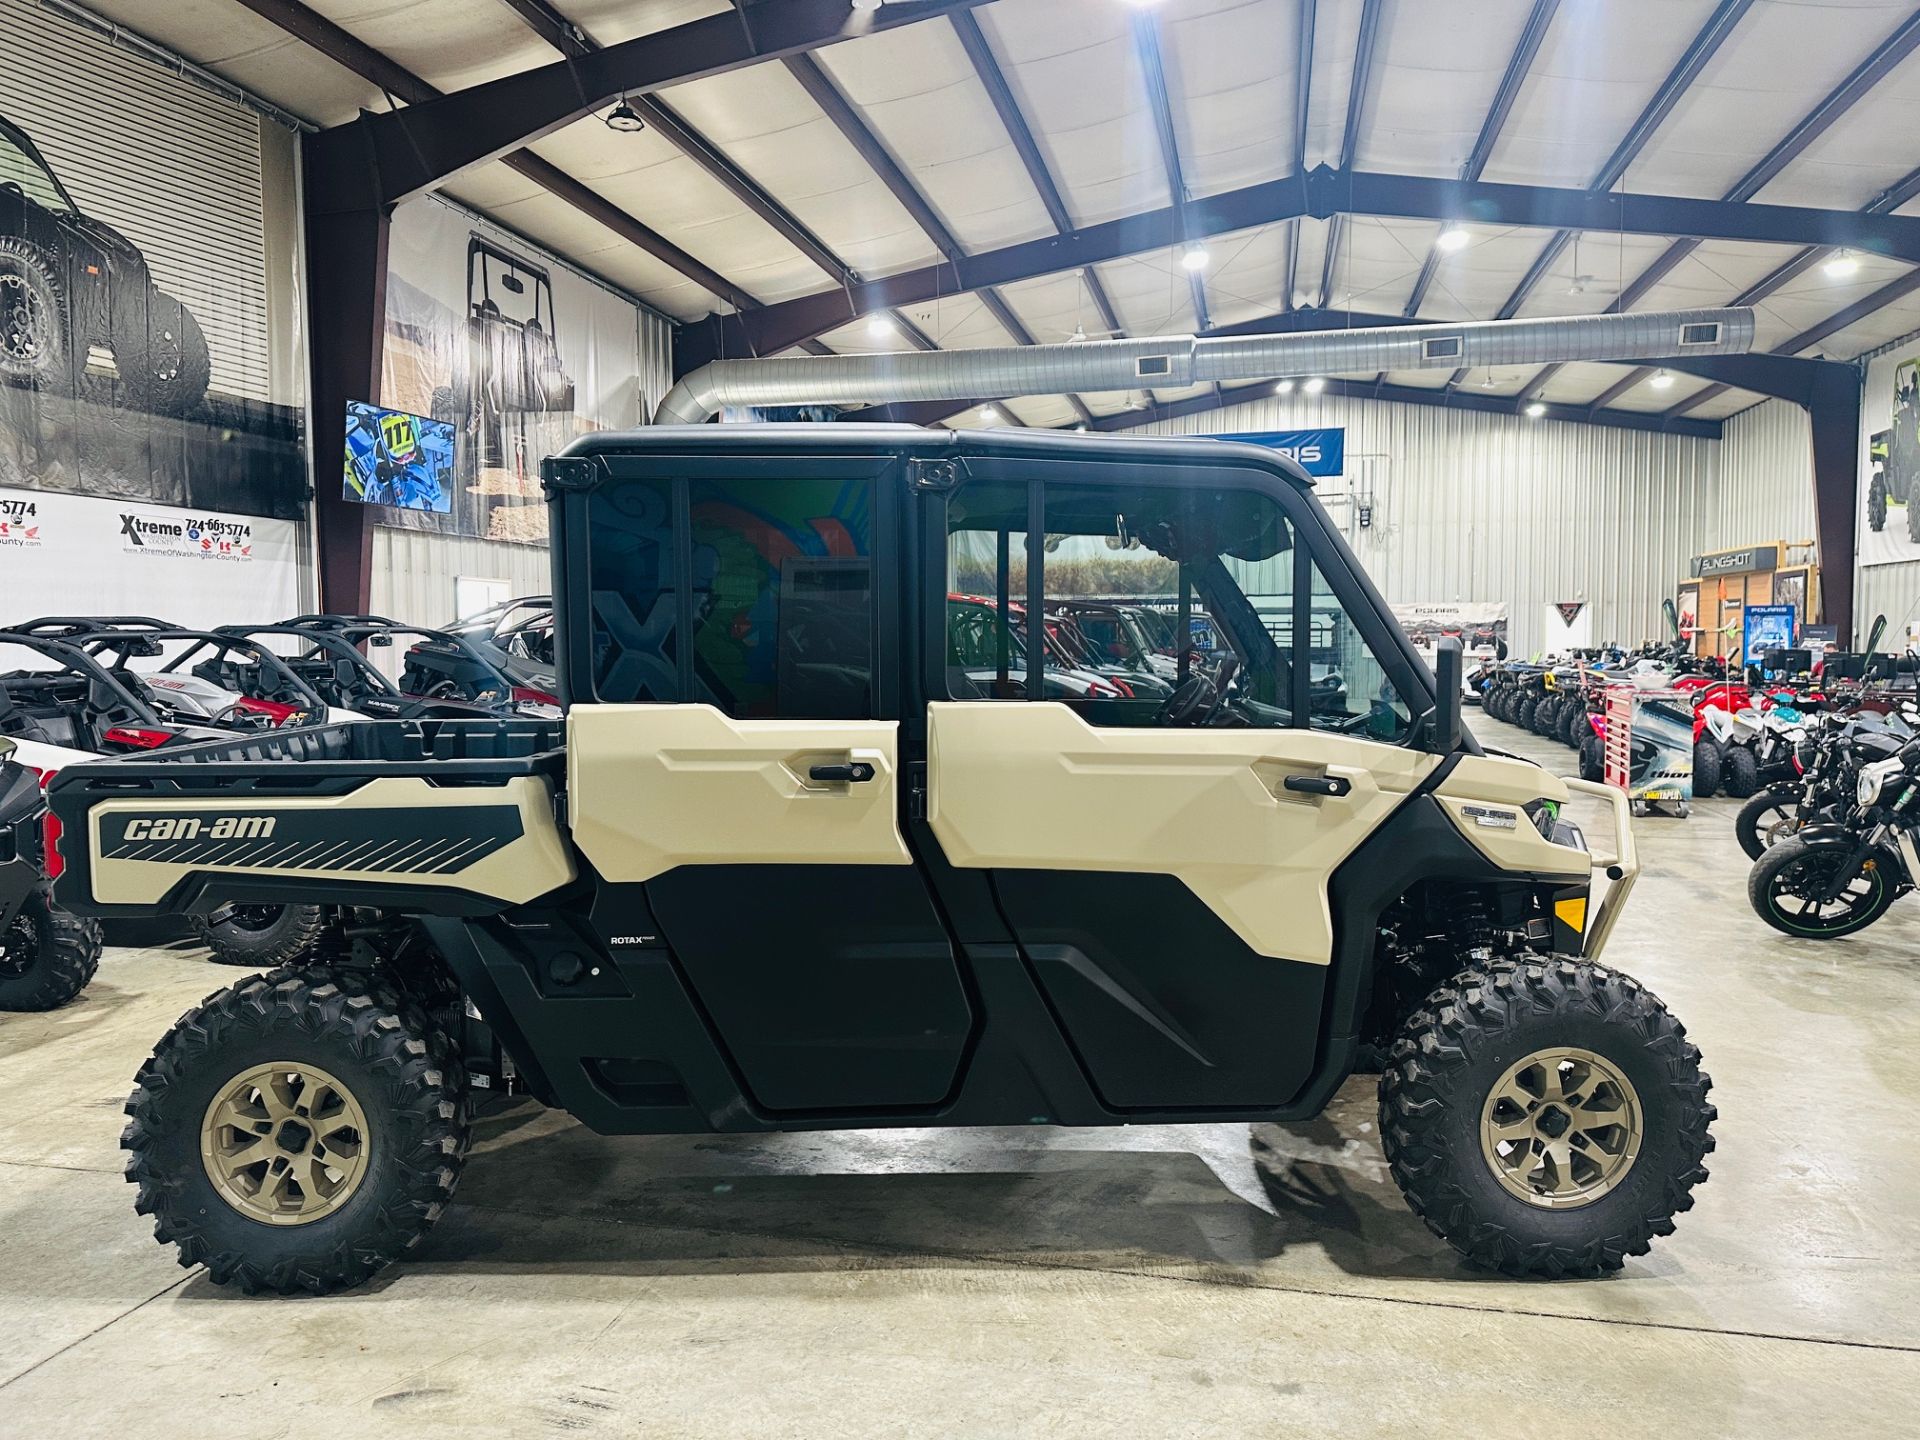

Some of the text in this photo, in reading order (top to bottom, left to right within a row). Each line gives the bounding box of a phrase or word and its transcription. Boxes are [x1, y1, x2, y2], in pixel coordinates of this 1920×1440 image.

[384, 421, 412, 450] 117
[119, 514, 182, 546] Xtreme
[185, 518, 251, 537] 724-663-5774
[1702, 552, 1750, 571] SLINGSHOT
[123, 815, 276, 841] can-am
[611, 936, 642, 944] ROTAX
